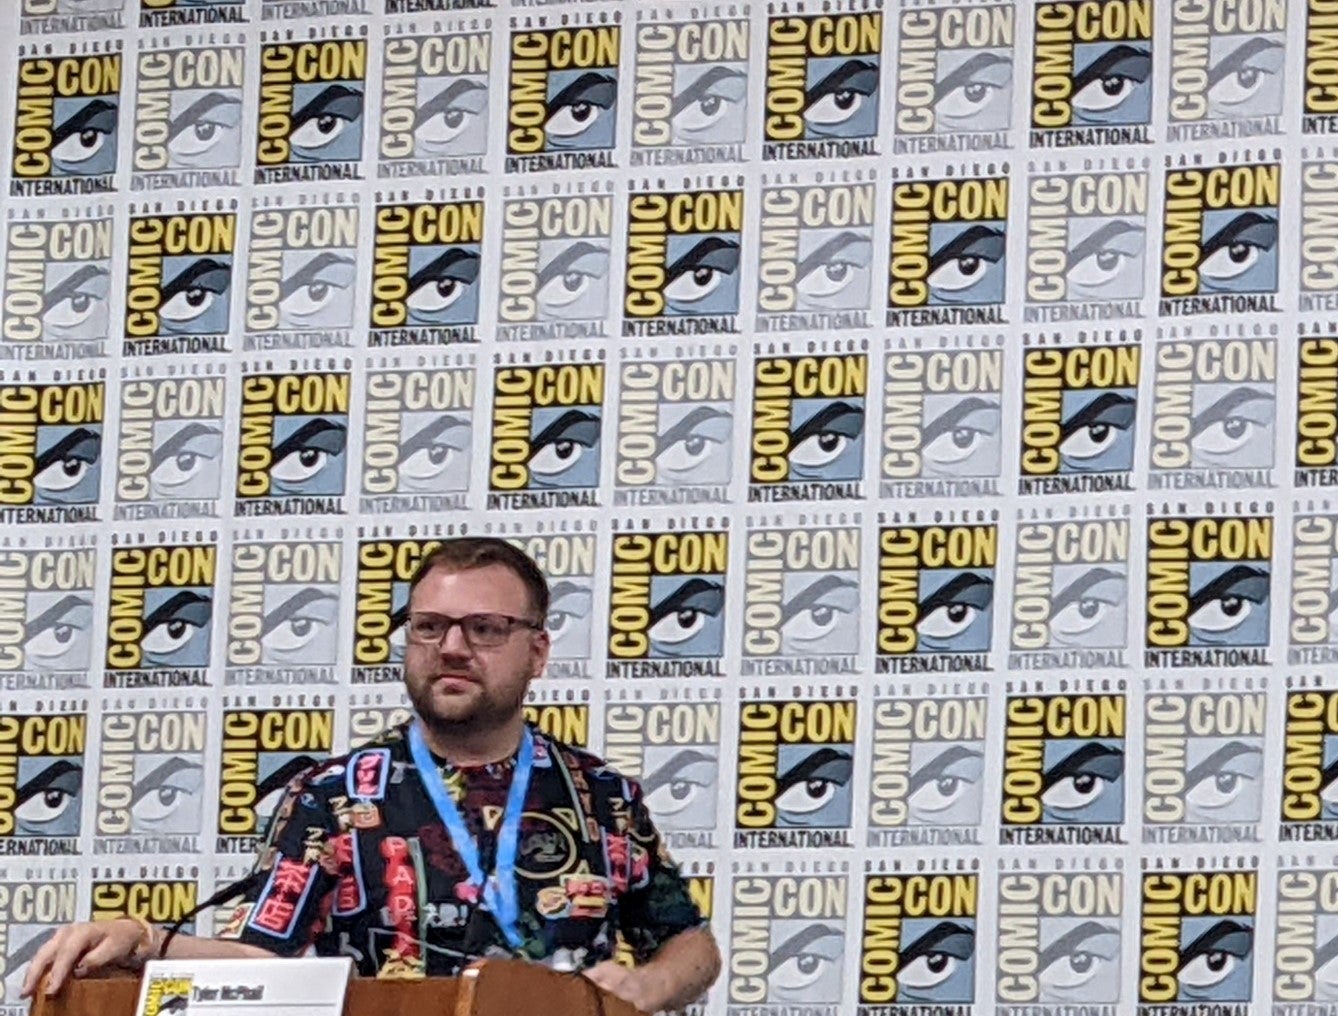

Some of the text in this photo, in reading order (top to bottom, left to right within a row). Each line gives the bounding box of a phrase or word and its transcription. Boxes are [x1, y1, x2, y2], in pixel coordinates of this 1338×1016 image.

[768, 0, 883, 14] SAN DIEGO
[260, 25, 368, 42] SAN DIEGO
[810, 16, 882, 55] CON
[296, 44, 367, 81] CON
[767, 21, 808, 139] COMIC
[258, 46, 294, 162] COMIC
[763, 140, 881, 160] INTERNATIONAL
[1165, 149, 1280, 167] SAN DIEGO
[254, 164, 364, 185] INTERNATIONAL
[1206, 168, 1280, 206] CON
[376, 187, 483, 202] SAN DIEGO
[413, 205, 483, 243] CON
[1163, 172, 1203, 294] COMIC
[373, 205, 410, 325] COMIC
[1159, 296, 1283, 316] INTERNATIONAL
[368, 327, 479, 345] INTERNATIONAL
[1299, 323, 1336, 334] SAN
[241, 358, 351, 372] SAN DIEGO
[277, 376, 350, 413] CON
[1298, 339, 1338, 464] COMIC
[236, 376, 275, 495] COMIC
[235, 498, 346, 517] INTERNATIONAL
[740, 687, 856, 698] SAN DIEGO
[780, 704, 856, 742] CON
[737, 703, 778, 826] COMIC
[734, 831, 854, 848] INTERNATIONAL
[866, 859, 978, 871] SAN DIEGO
[904, 877, 977, 915] CON
[861, 877, 903, 1001] COMIC
